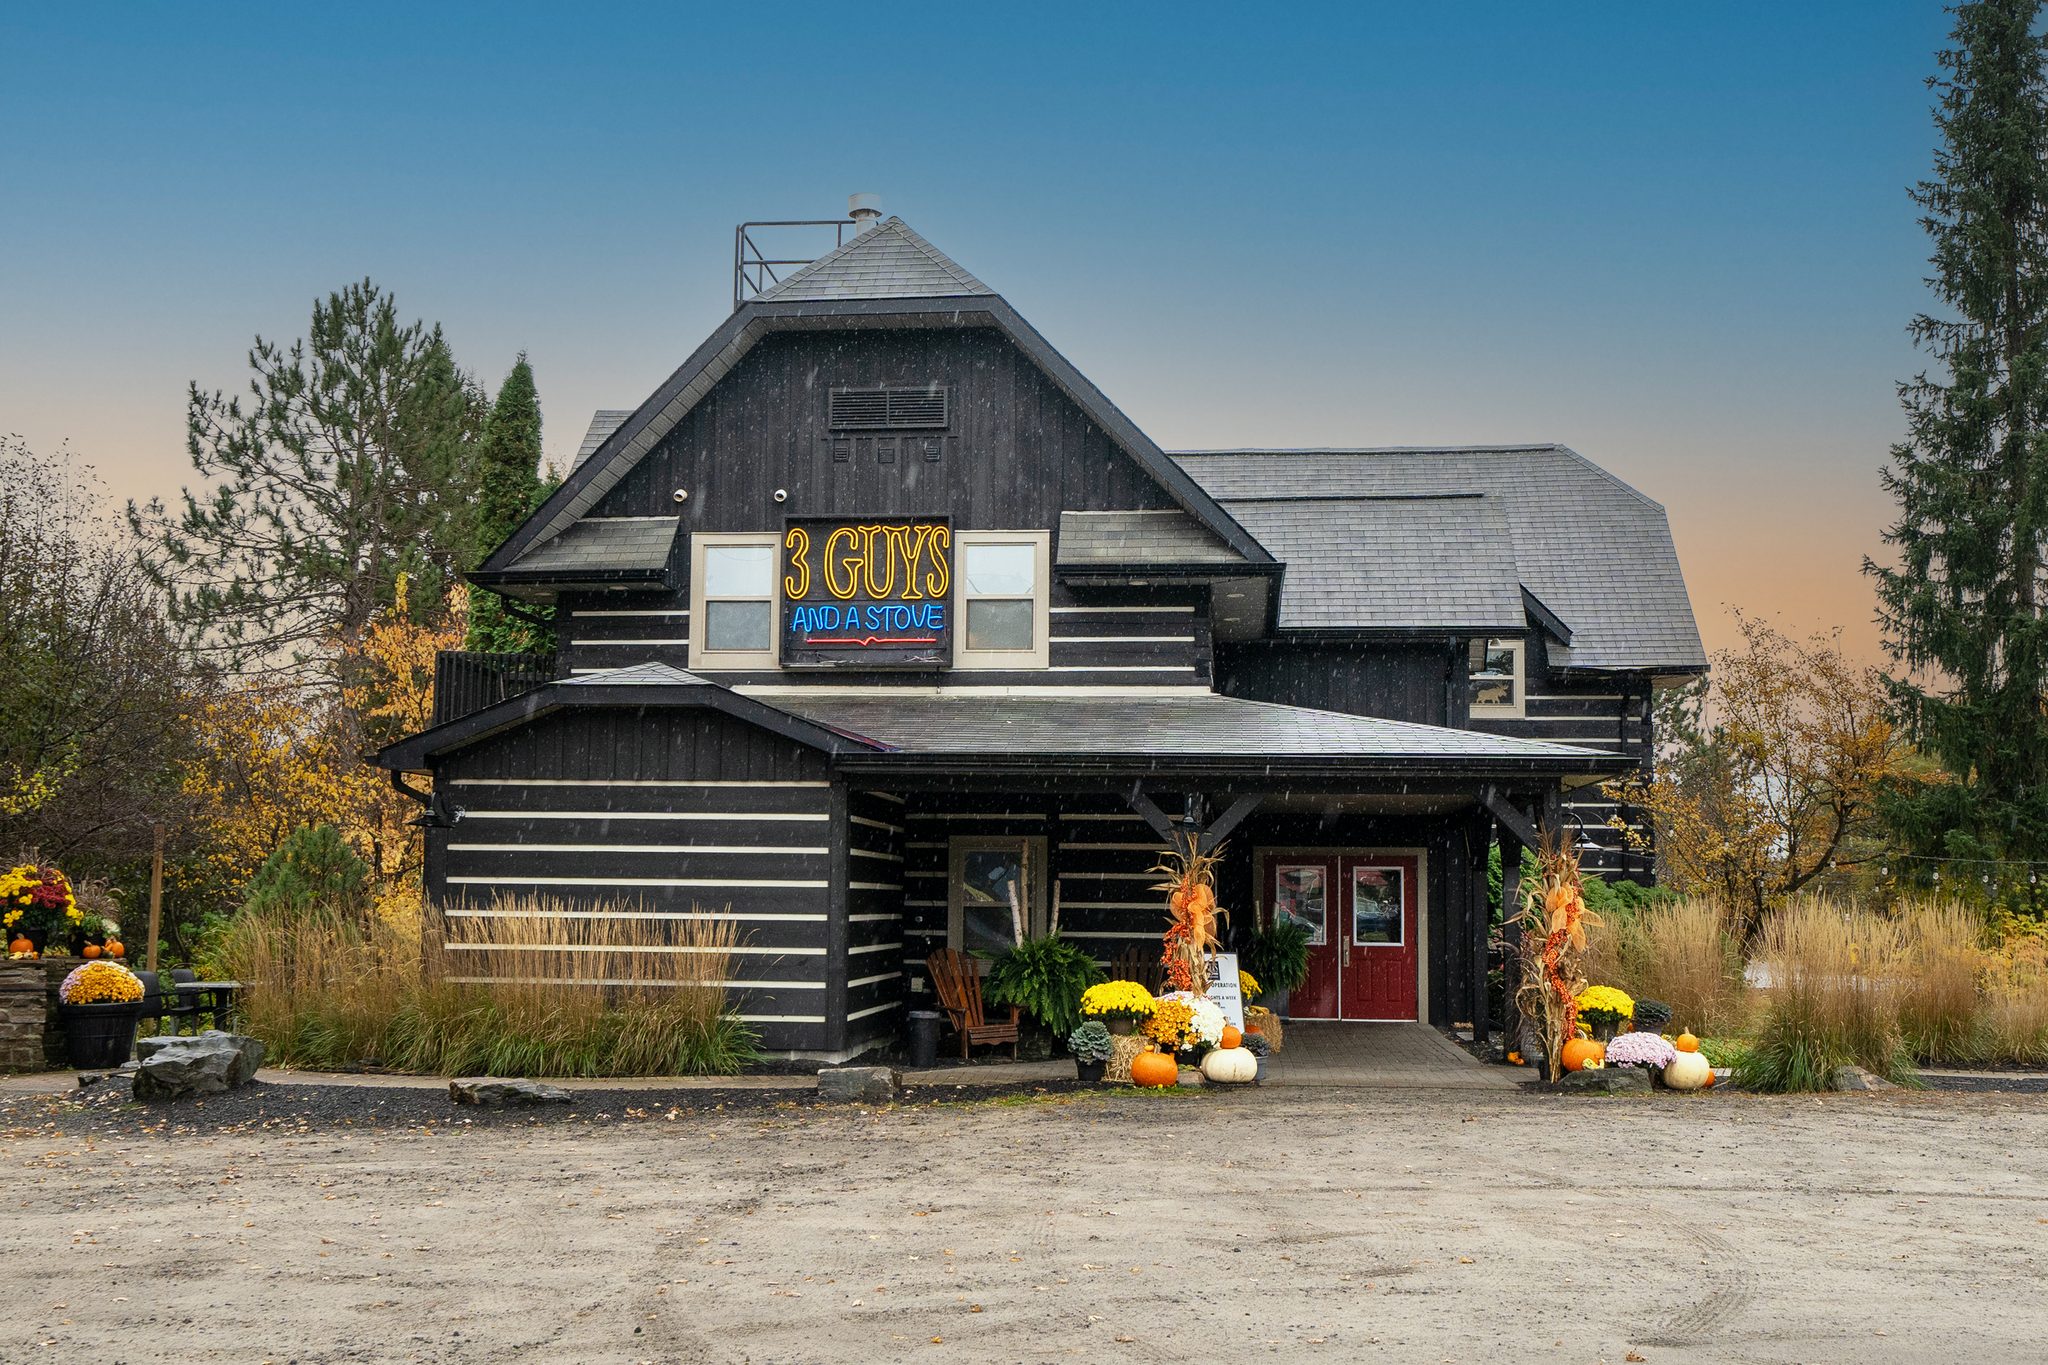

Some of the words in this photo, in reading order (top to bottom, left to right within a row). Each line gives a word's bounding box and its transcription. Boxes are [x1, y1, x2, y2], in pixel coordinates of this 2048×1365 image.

[785, 528, 810, 599] 3
[824, 525, 949, 599] GUYS
[792, 605, 840, 632] AND
[845, 606, 860, 630] A
[865, 603, 944, 631] STOVE
